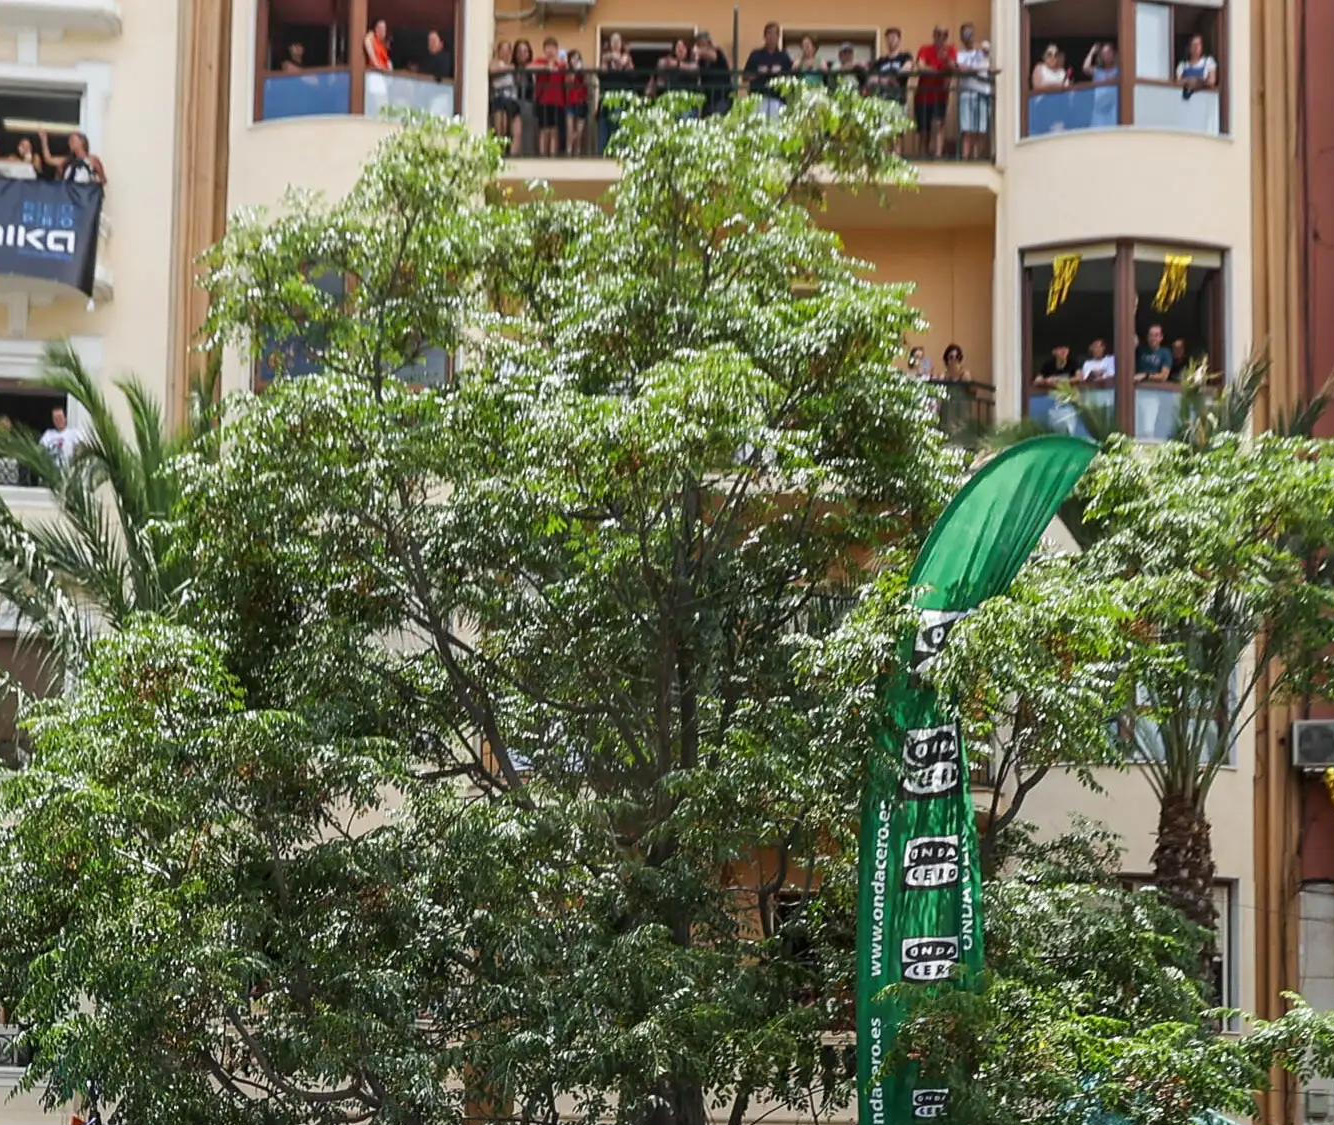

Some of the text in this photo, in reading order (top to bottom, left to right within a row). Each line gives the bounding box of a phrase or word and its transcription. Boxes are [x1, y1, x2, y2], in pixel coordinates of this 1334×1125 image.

[908, 845, 956, 861] ONDA
[911, 865, 957, 882] CERO
[909, 942, 956, 957] ONDA
[912, 964, 948, 977] CER
